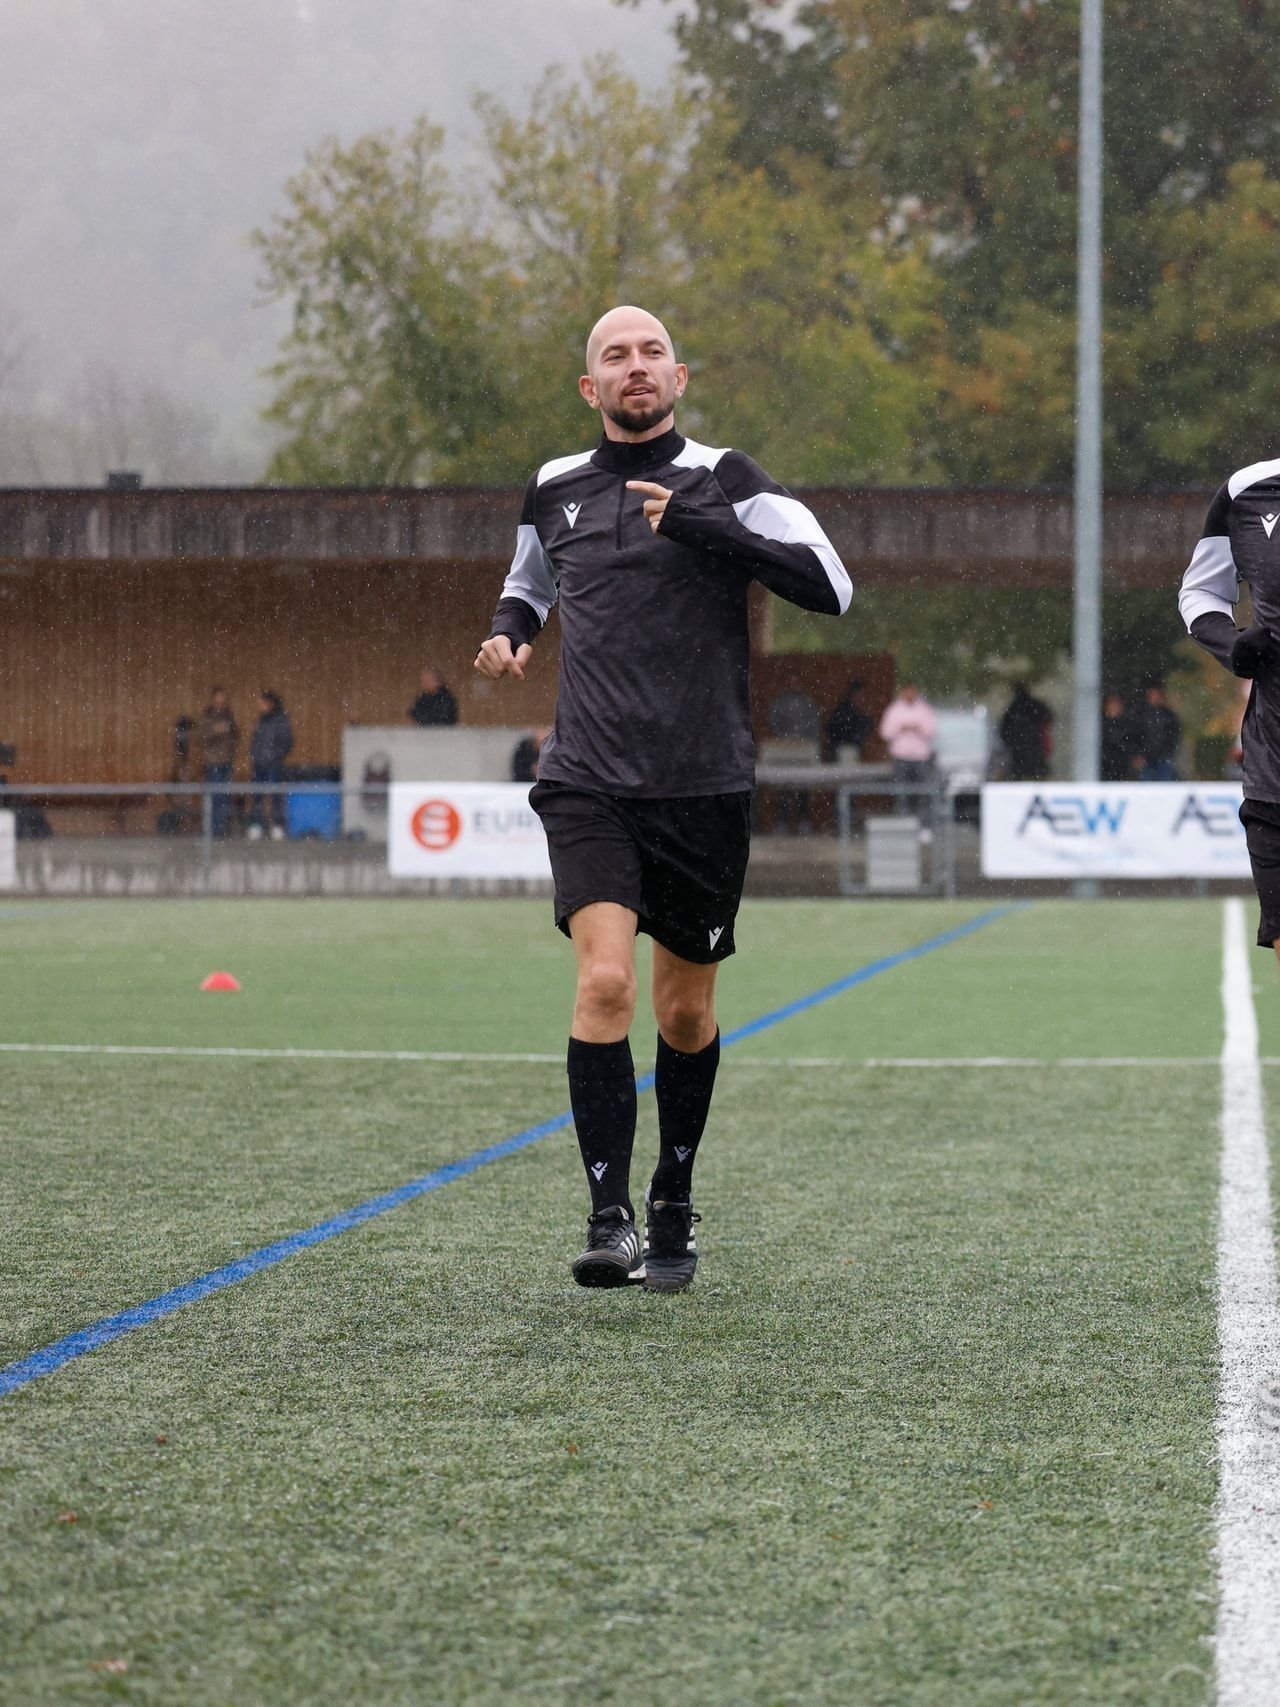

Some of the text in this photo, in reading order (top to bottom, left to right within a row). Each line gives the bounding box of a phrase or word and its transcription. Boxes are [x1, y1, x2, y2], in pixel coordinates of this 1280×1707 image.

[473, 810, 543, 833] EUR
[1016, 794, 1127, 836] AEW
[1171, 794, 1245, 836] AE
